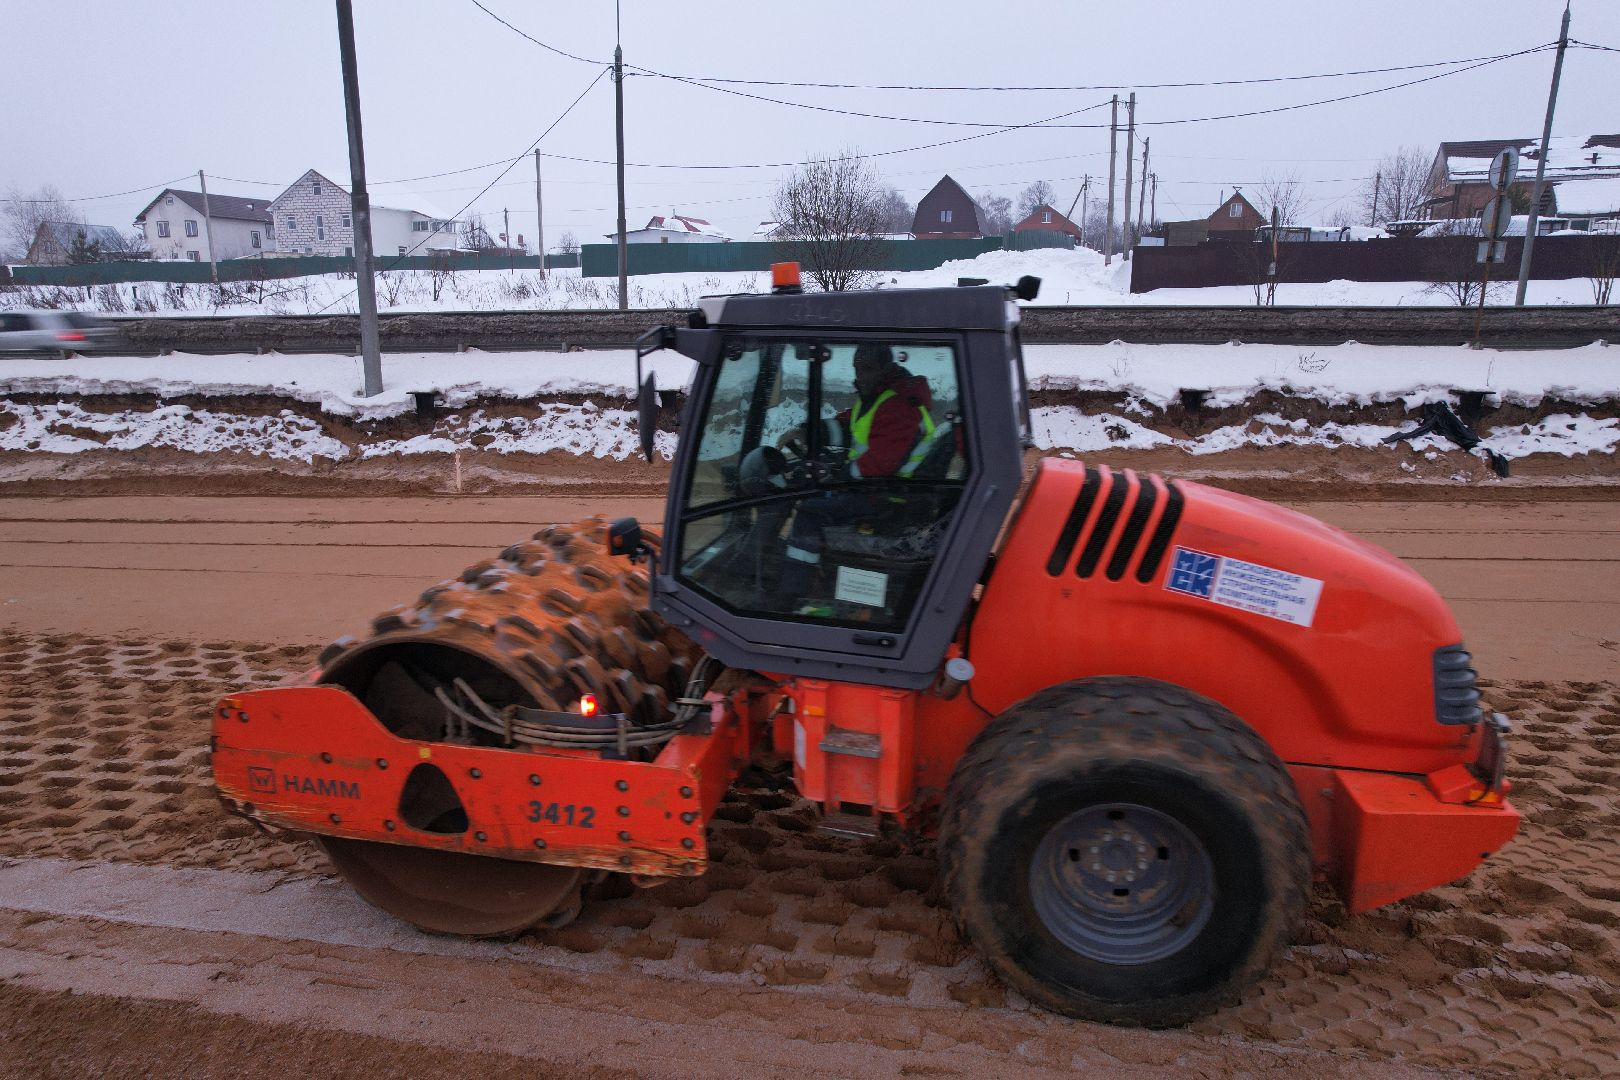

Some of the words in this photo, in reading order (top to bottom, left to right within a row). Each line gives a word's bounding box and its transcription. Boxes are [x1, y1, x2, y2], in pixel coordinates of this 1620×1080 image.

[1224, 559, 1301, 583] МОСКОВСКАЯ
[1218, 587, 1279, 608] КОМПАНИЯ
[1220, 577, 1307, 605] СТРОИТЕЛЬНАЯ
[283, 774, 361, 800] HAMM
[527, 800, 596, 829] 3412
